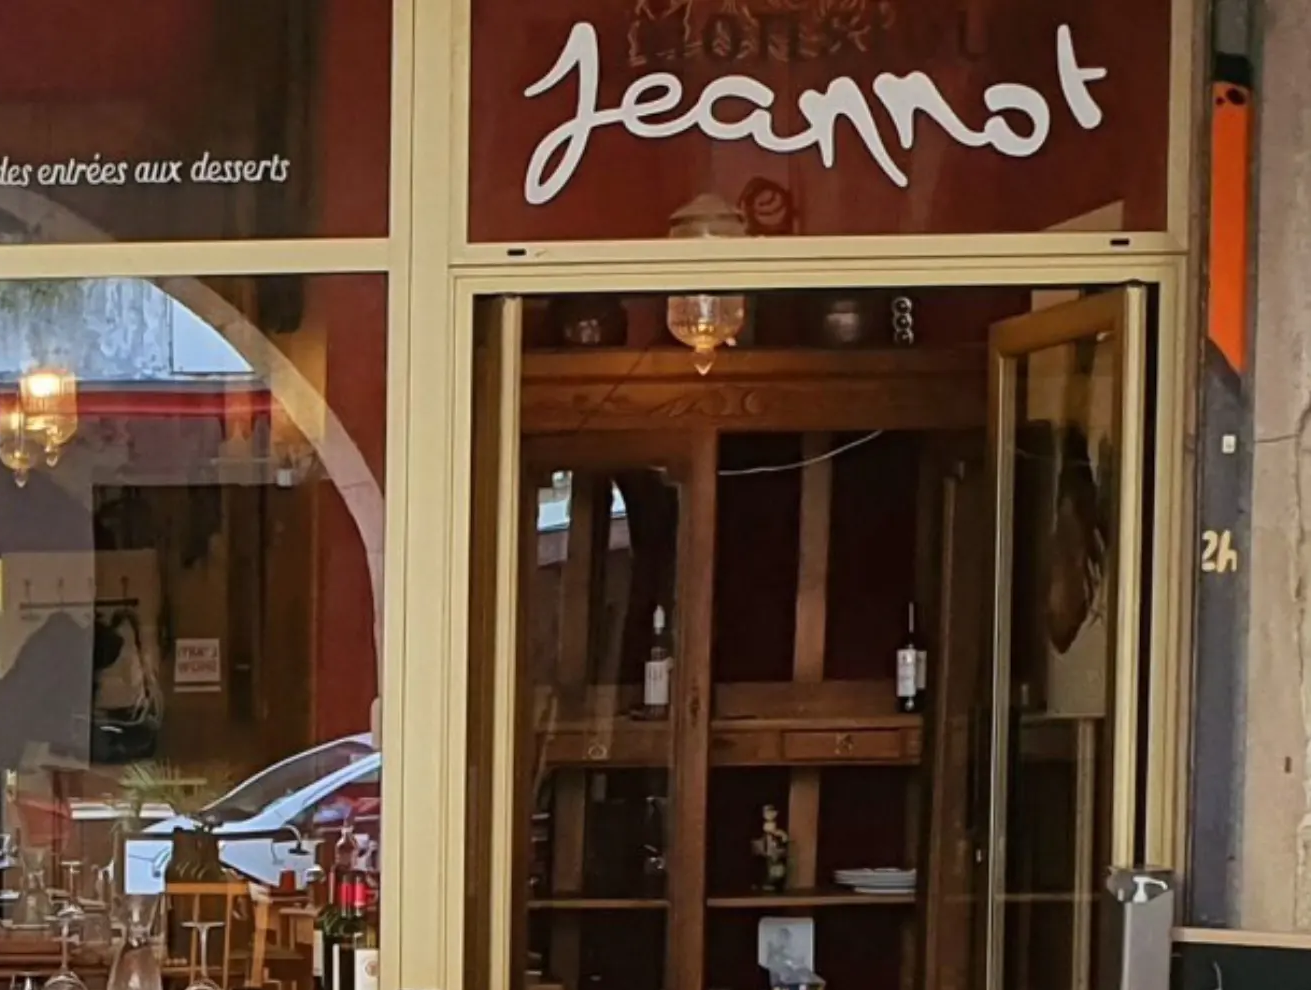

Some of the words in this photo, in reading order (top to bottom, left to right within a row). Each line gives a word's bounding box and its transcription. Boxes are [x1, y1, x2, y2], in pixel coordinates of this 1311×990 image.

[524, 22, 1108, 205] Jeannot
[37, 152, 127, 186] entrées
[134, 160, 182, 183] aux
[189, 151, 290, 183] desserts
